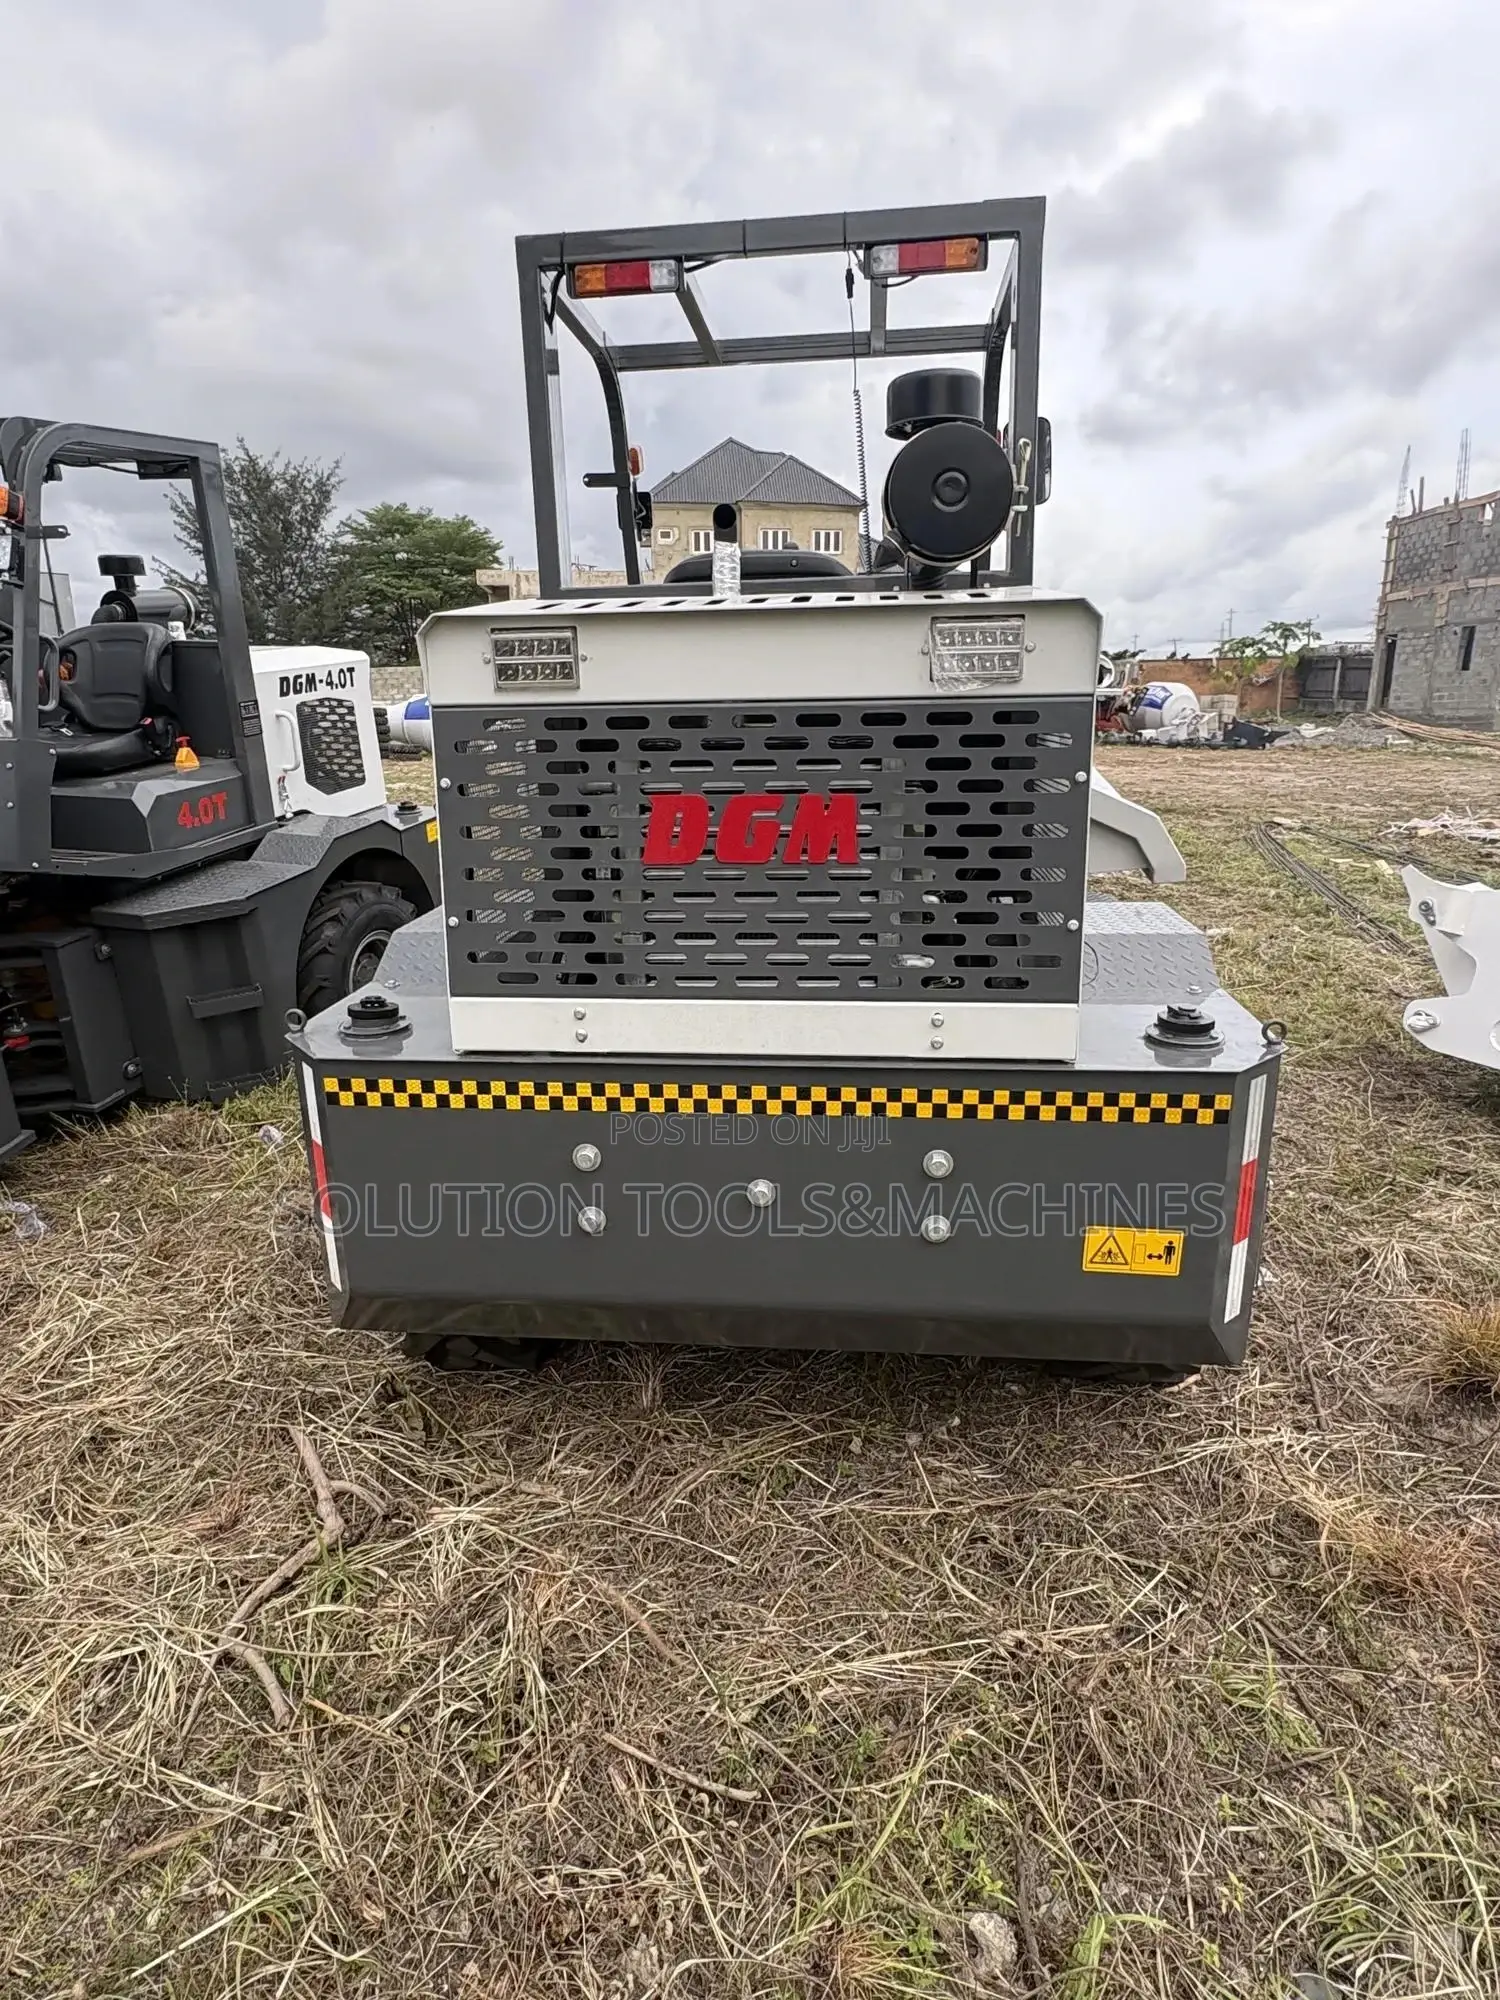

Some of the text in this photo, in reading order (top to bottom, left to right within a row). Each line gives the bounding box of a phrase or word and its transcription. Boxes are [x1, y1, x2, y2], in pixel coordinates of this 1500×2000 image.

[279, 667, 355, 697] DGM-4.0T
[178, 792, 228, 829] 4.0T
[641, 793, 861, 865] DGM
